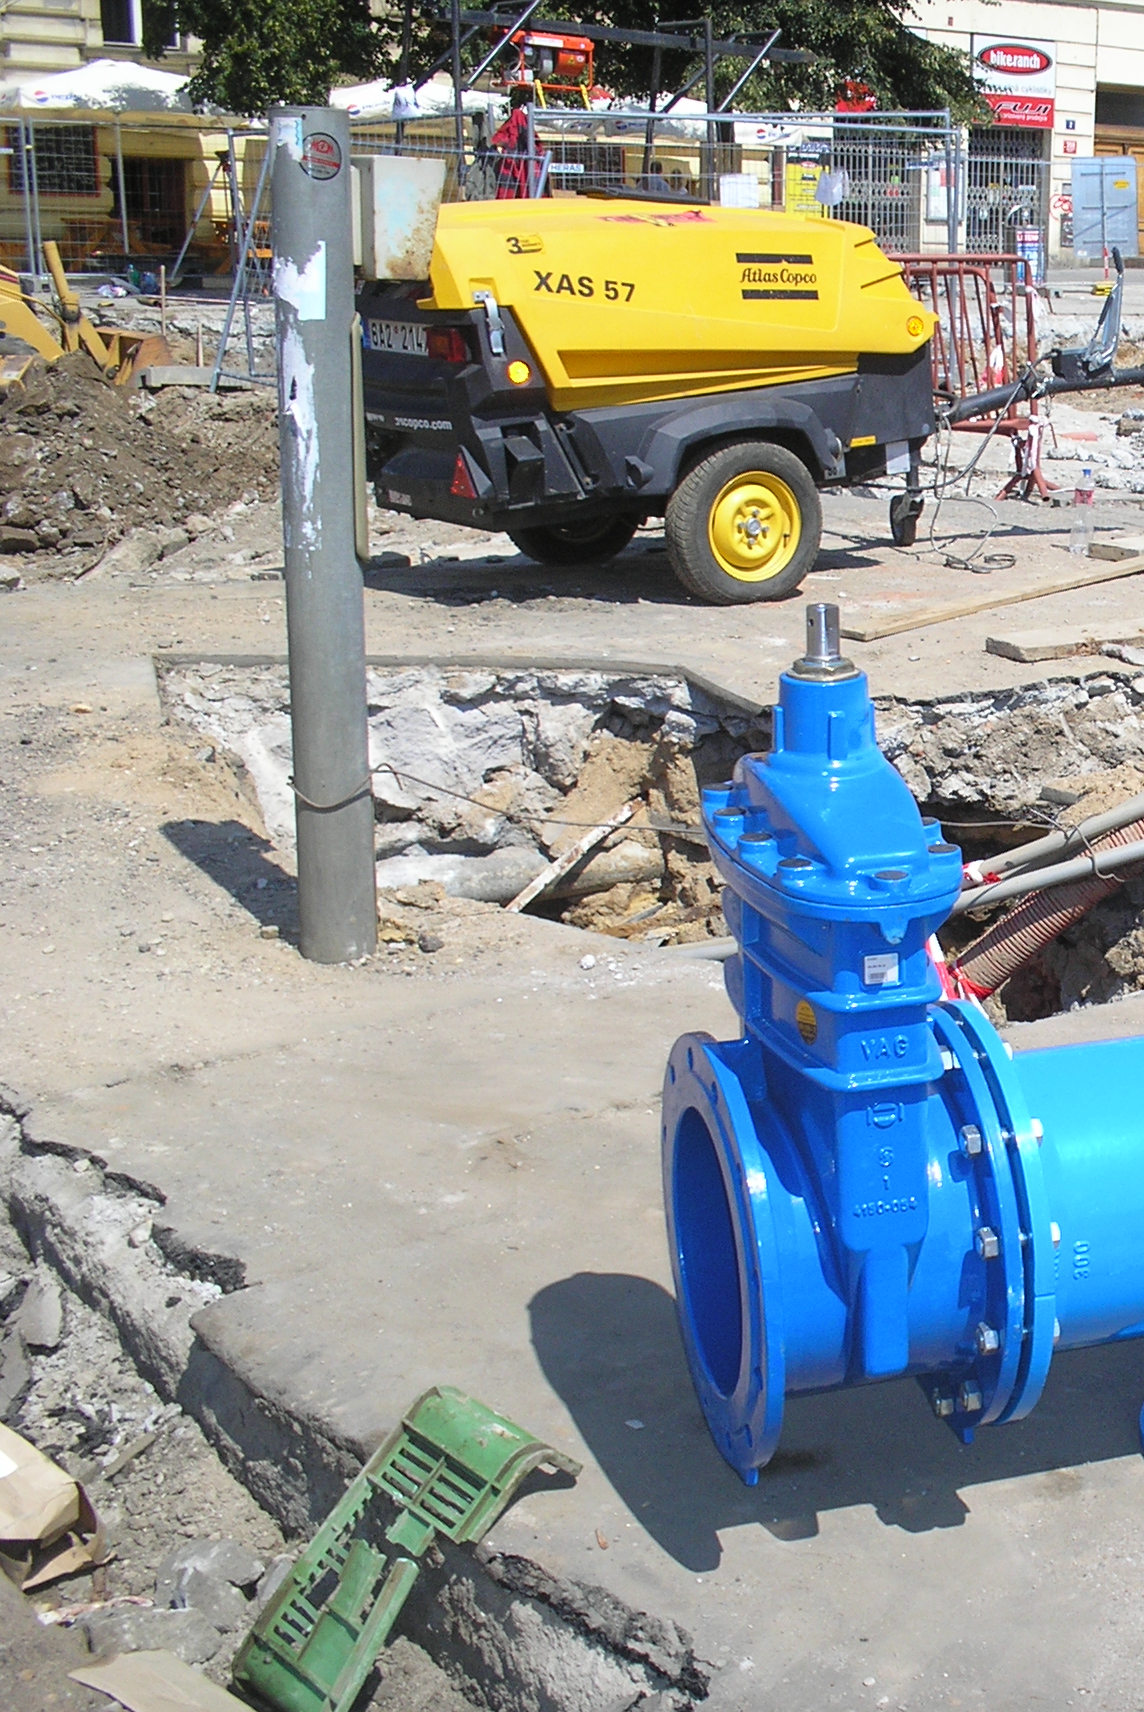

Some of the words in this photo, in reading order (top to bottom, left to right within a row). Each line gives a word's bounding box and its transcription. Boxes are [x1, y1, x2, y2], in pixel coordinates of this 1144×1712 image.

[550, 164, 582, 172] HERAS
[506, 236, 523, 255] 3
[533, 270, 594, 298] XAS
[604, 281, 635, 303] 57
[740, 267, 779, 283] Atlas
[780, 269, 817, 286] Copco
[400, 325, 428, 353] 214
[861, 1034, 909, 1062] VAG
[1072, 1240, 1090, 1281] 300
